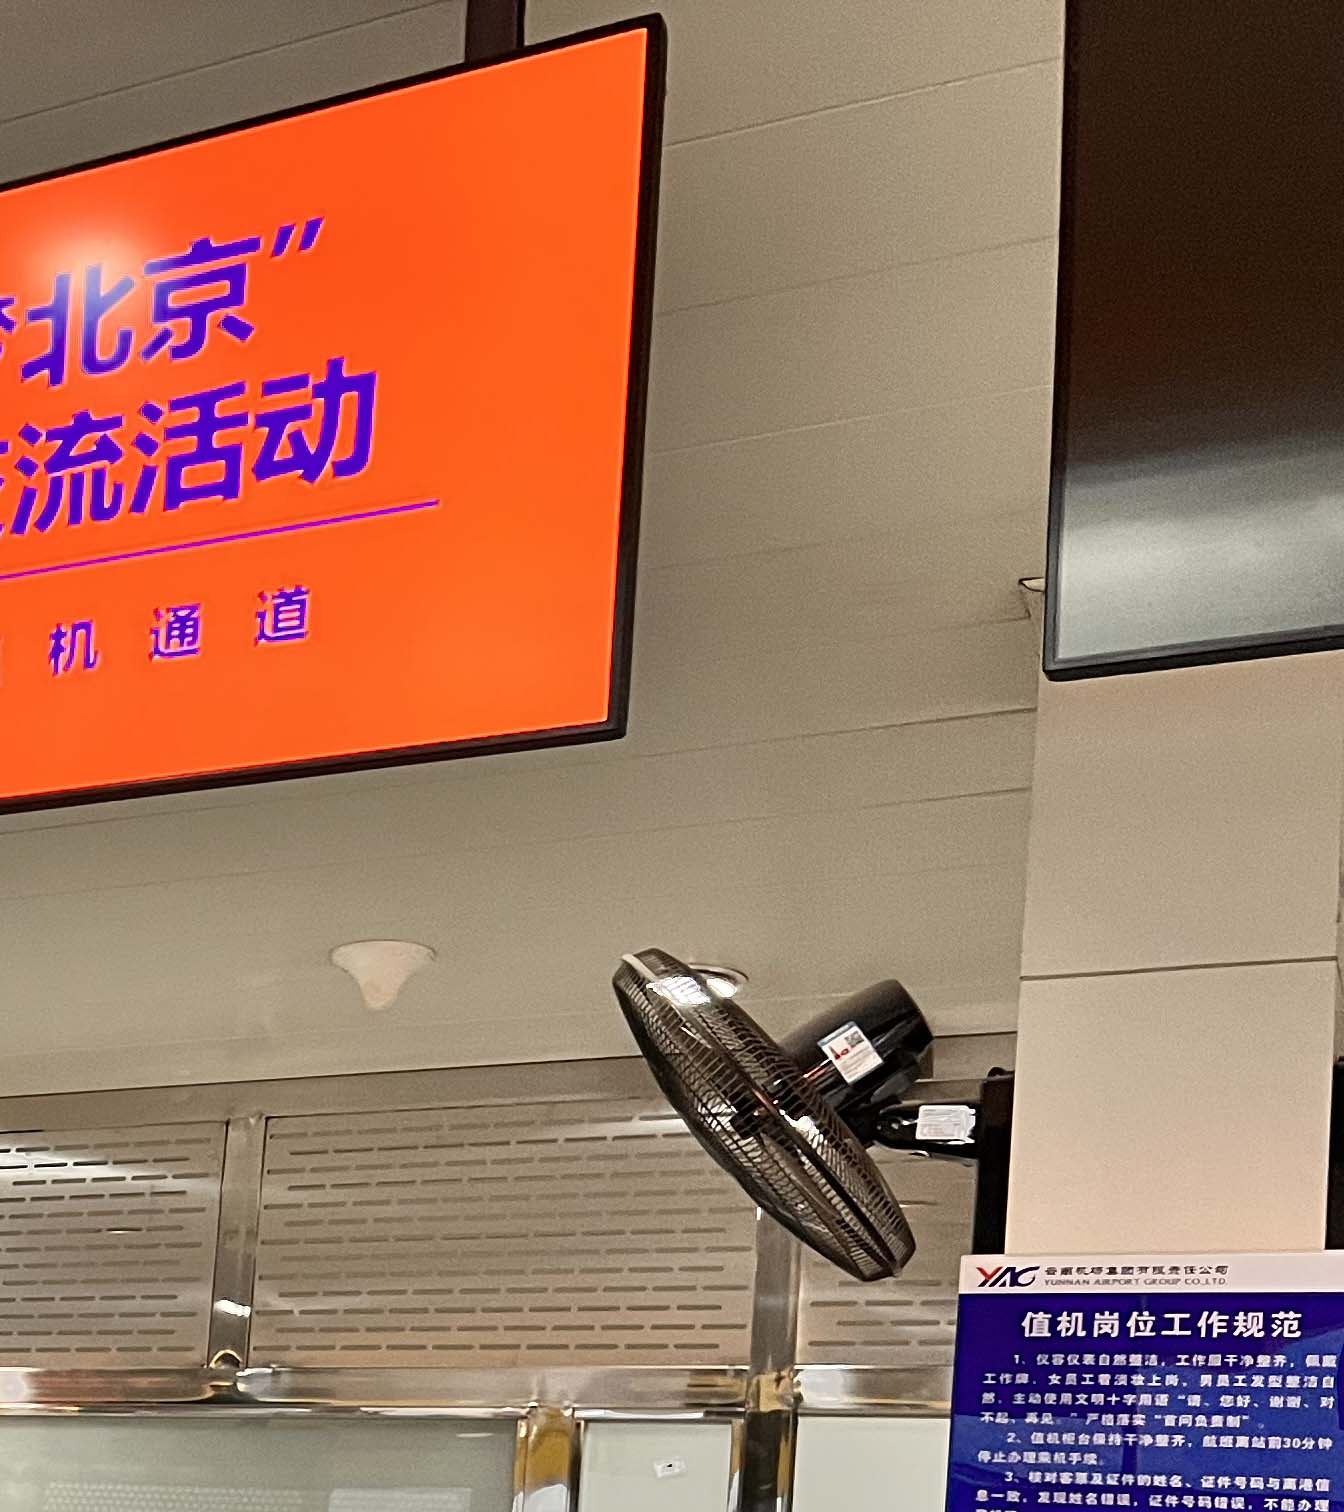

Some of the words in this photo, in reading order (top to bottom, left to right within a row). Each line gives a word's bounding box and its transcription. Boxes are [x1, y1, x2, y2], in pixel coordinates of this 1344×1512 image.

[1044, 1265, 1229, 1276] 云南机场集团有限责任公司
[1093, 1278, 1140, 1286] AIRPORT
[1021, 1310, 1303, 1338] 值机岗位工作规范
